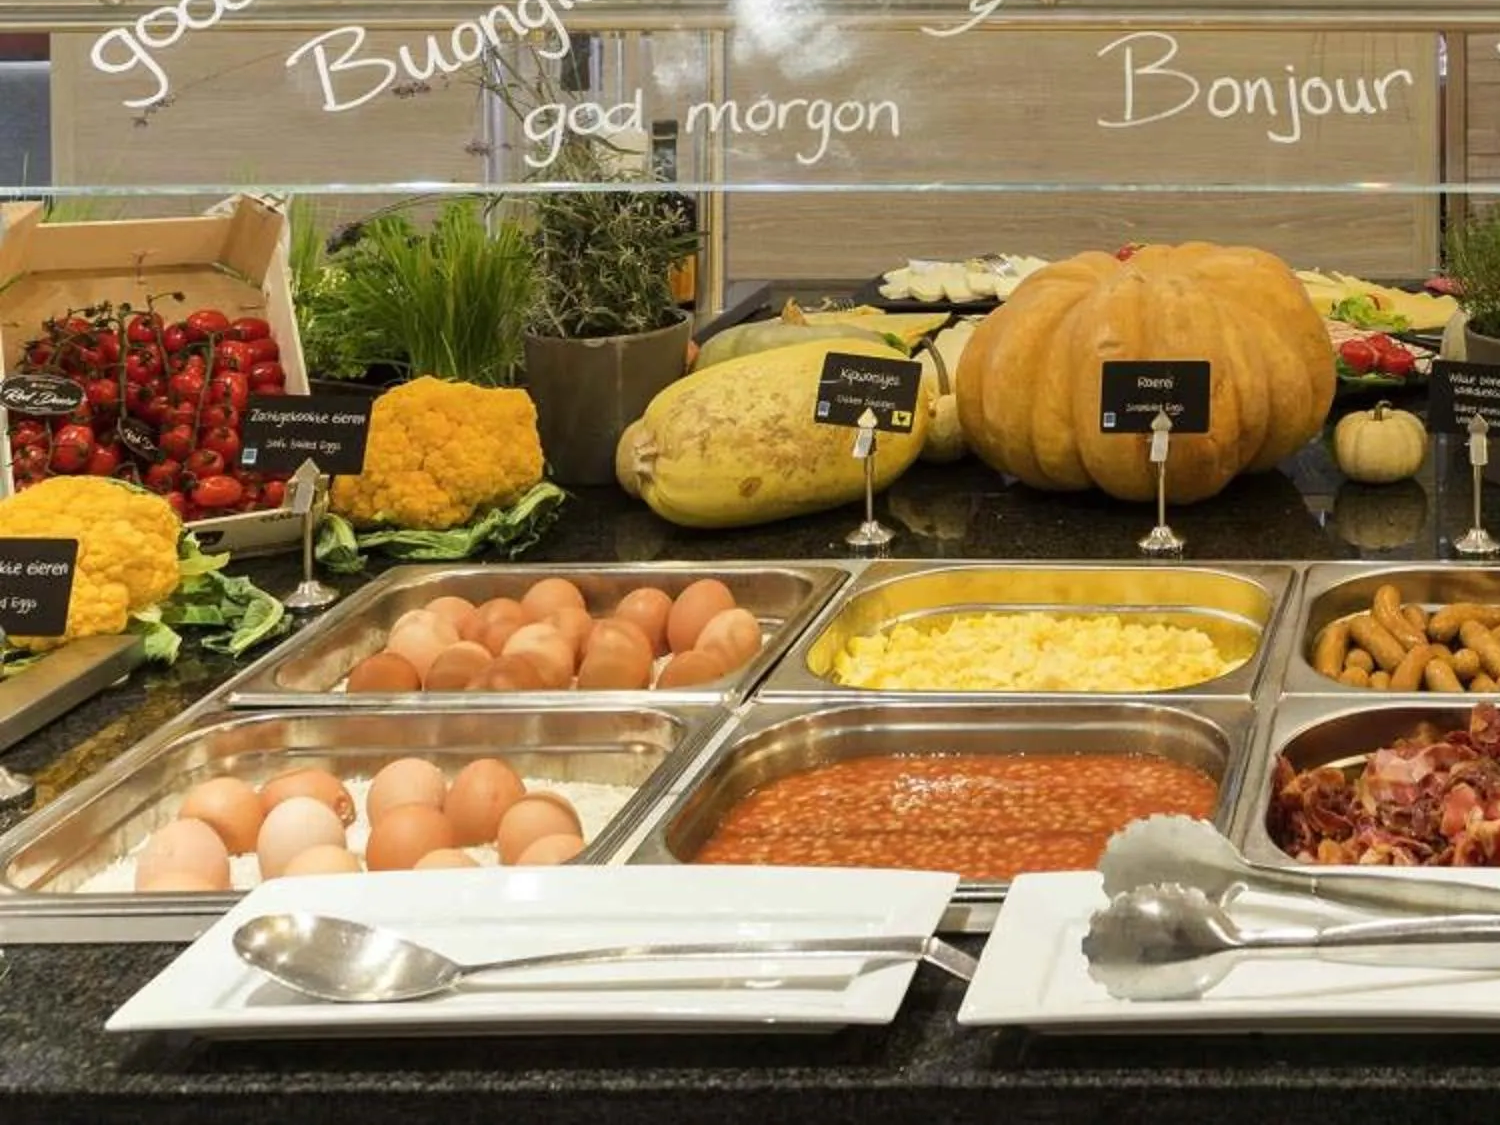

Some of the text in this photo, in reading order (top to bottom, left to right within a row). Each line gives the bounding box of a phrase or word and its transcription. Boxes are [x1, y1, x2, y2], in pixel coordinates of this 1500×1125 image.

[523, 88, 900, 167] god morgon
[1097, 30, 1413, 143] Bonjour
